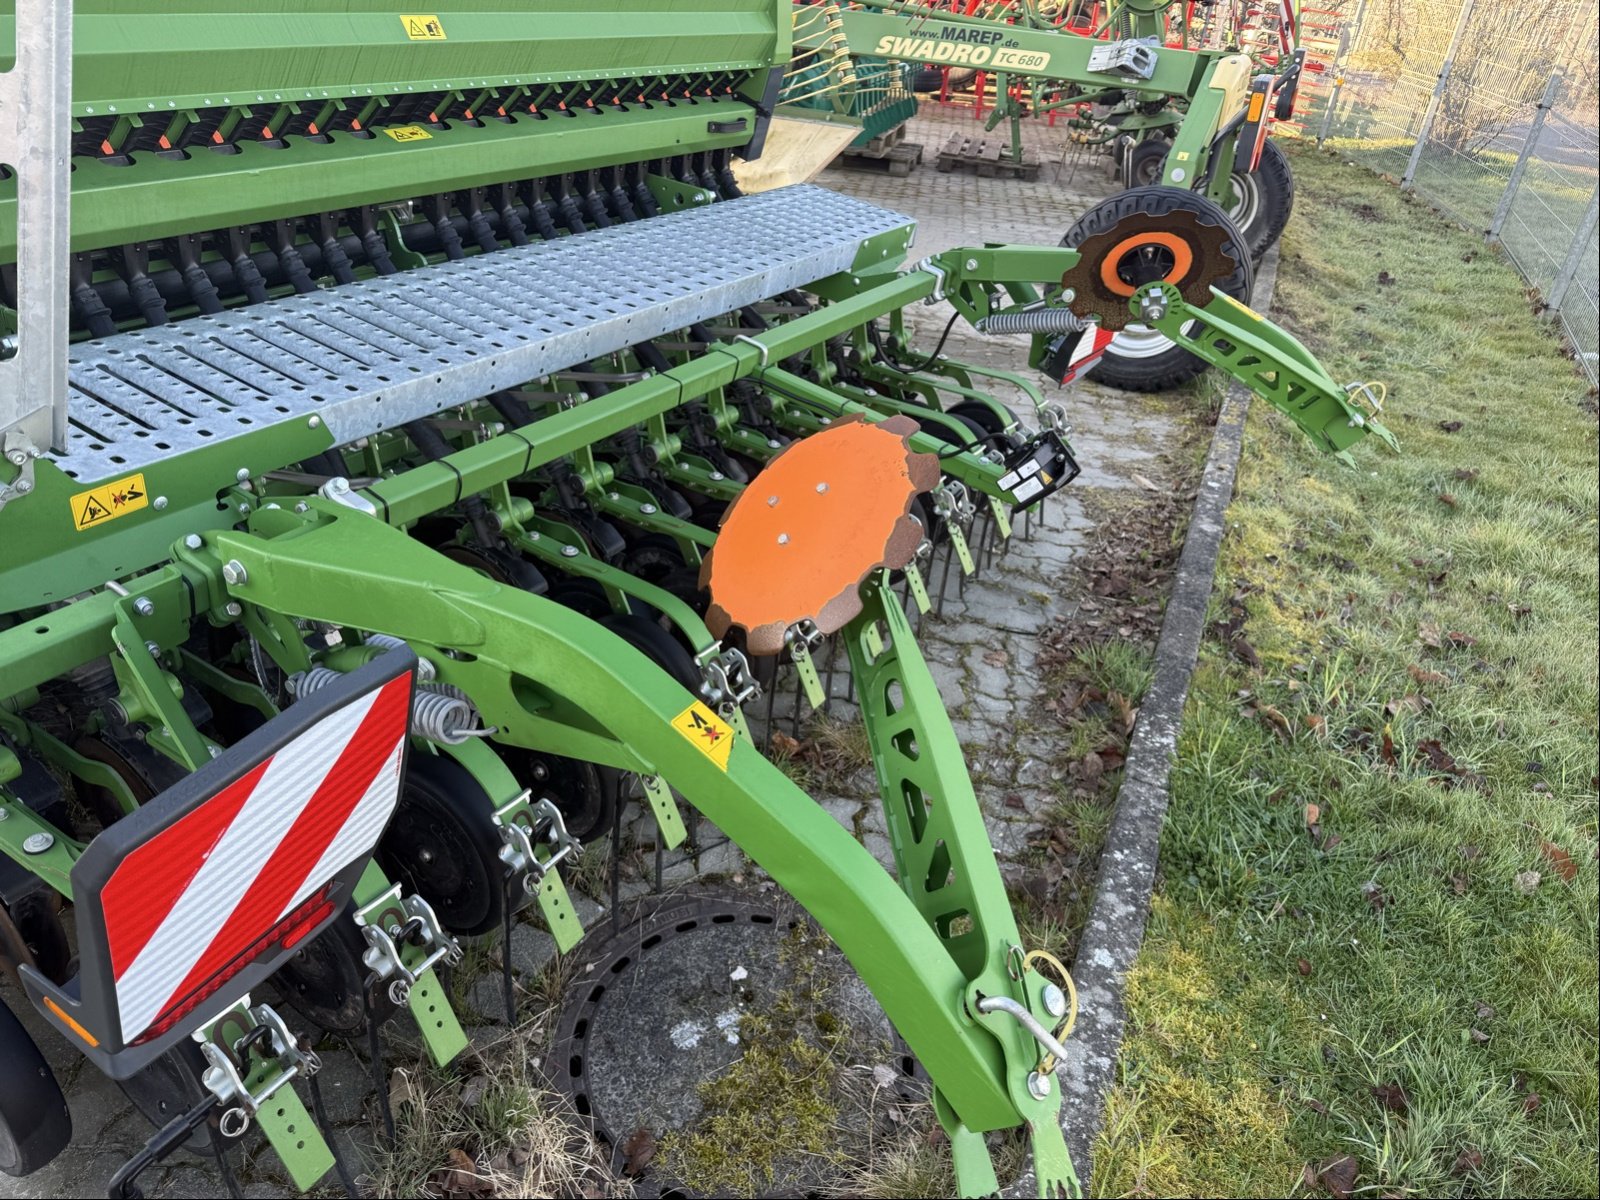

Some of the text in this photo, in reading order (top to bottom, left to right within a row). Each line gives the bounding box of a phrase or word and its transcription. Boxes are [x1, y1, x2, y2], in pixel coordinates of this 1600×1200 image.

[909, 26, 1020, 48] www.MAREP.de
[875, 35, 1044, 67] SWADRO TC 680
